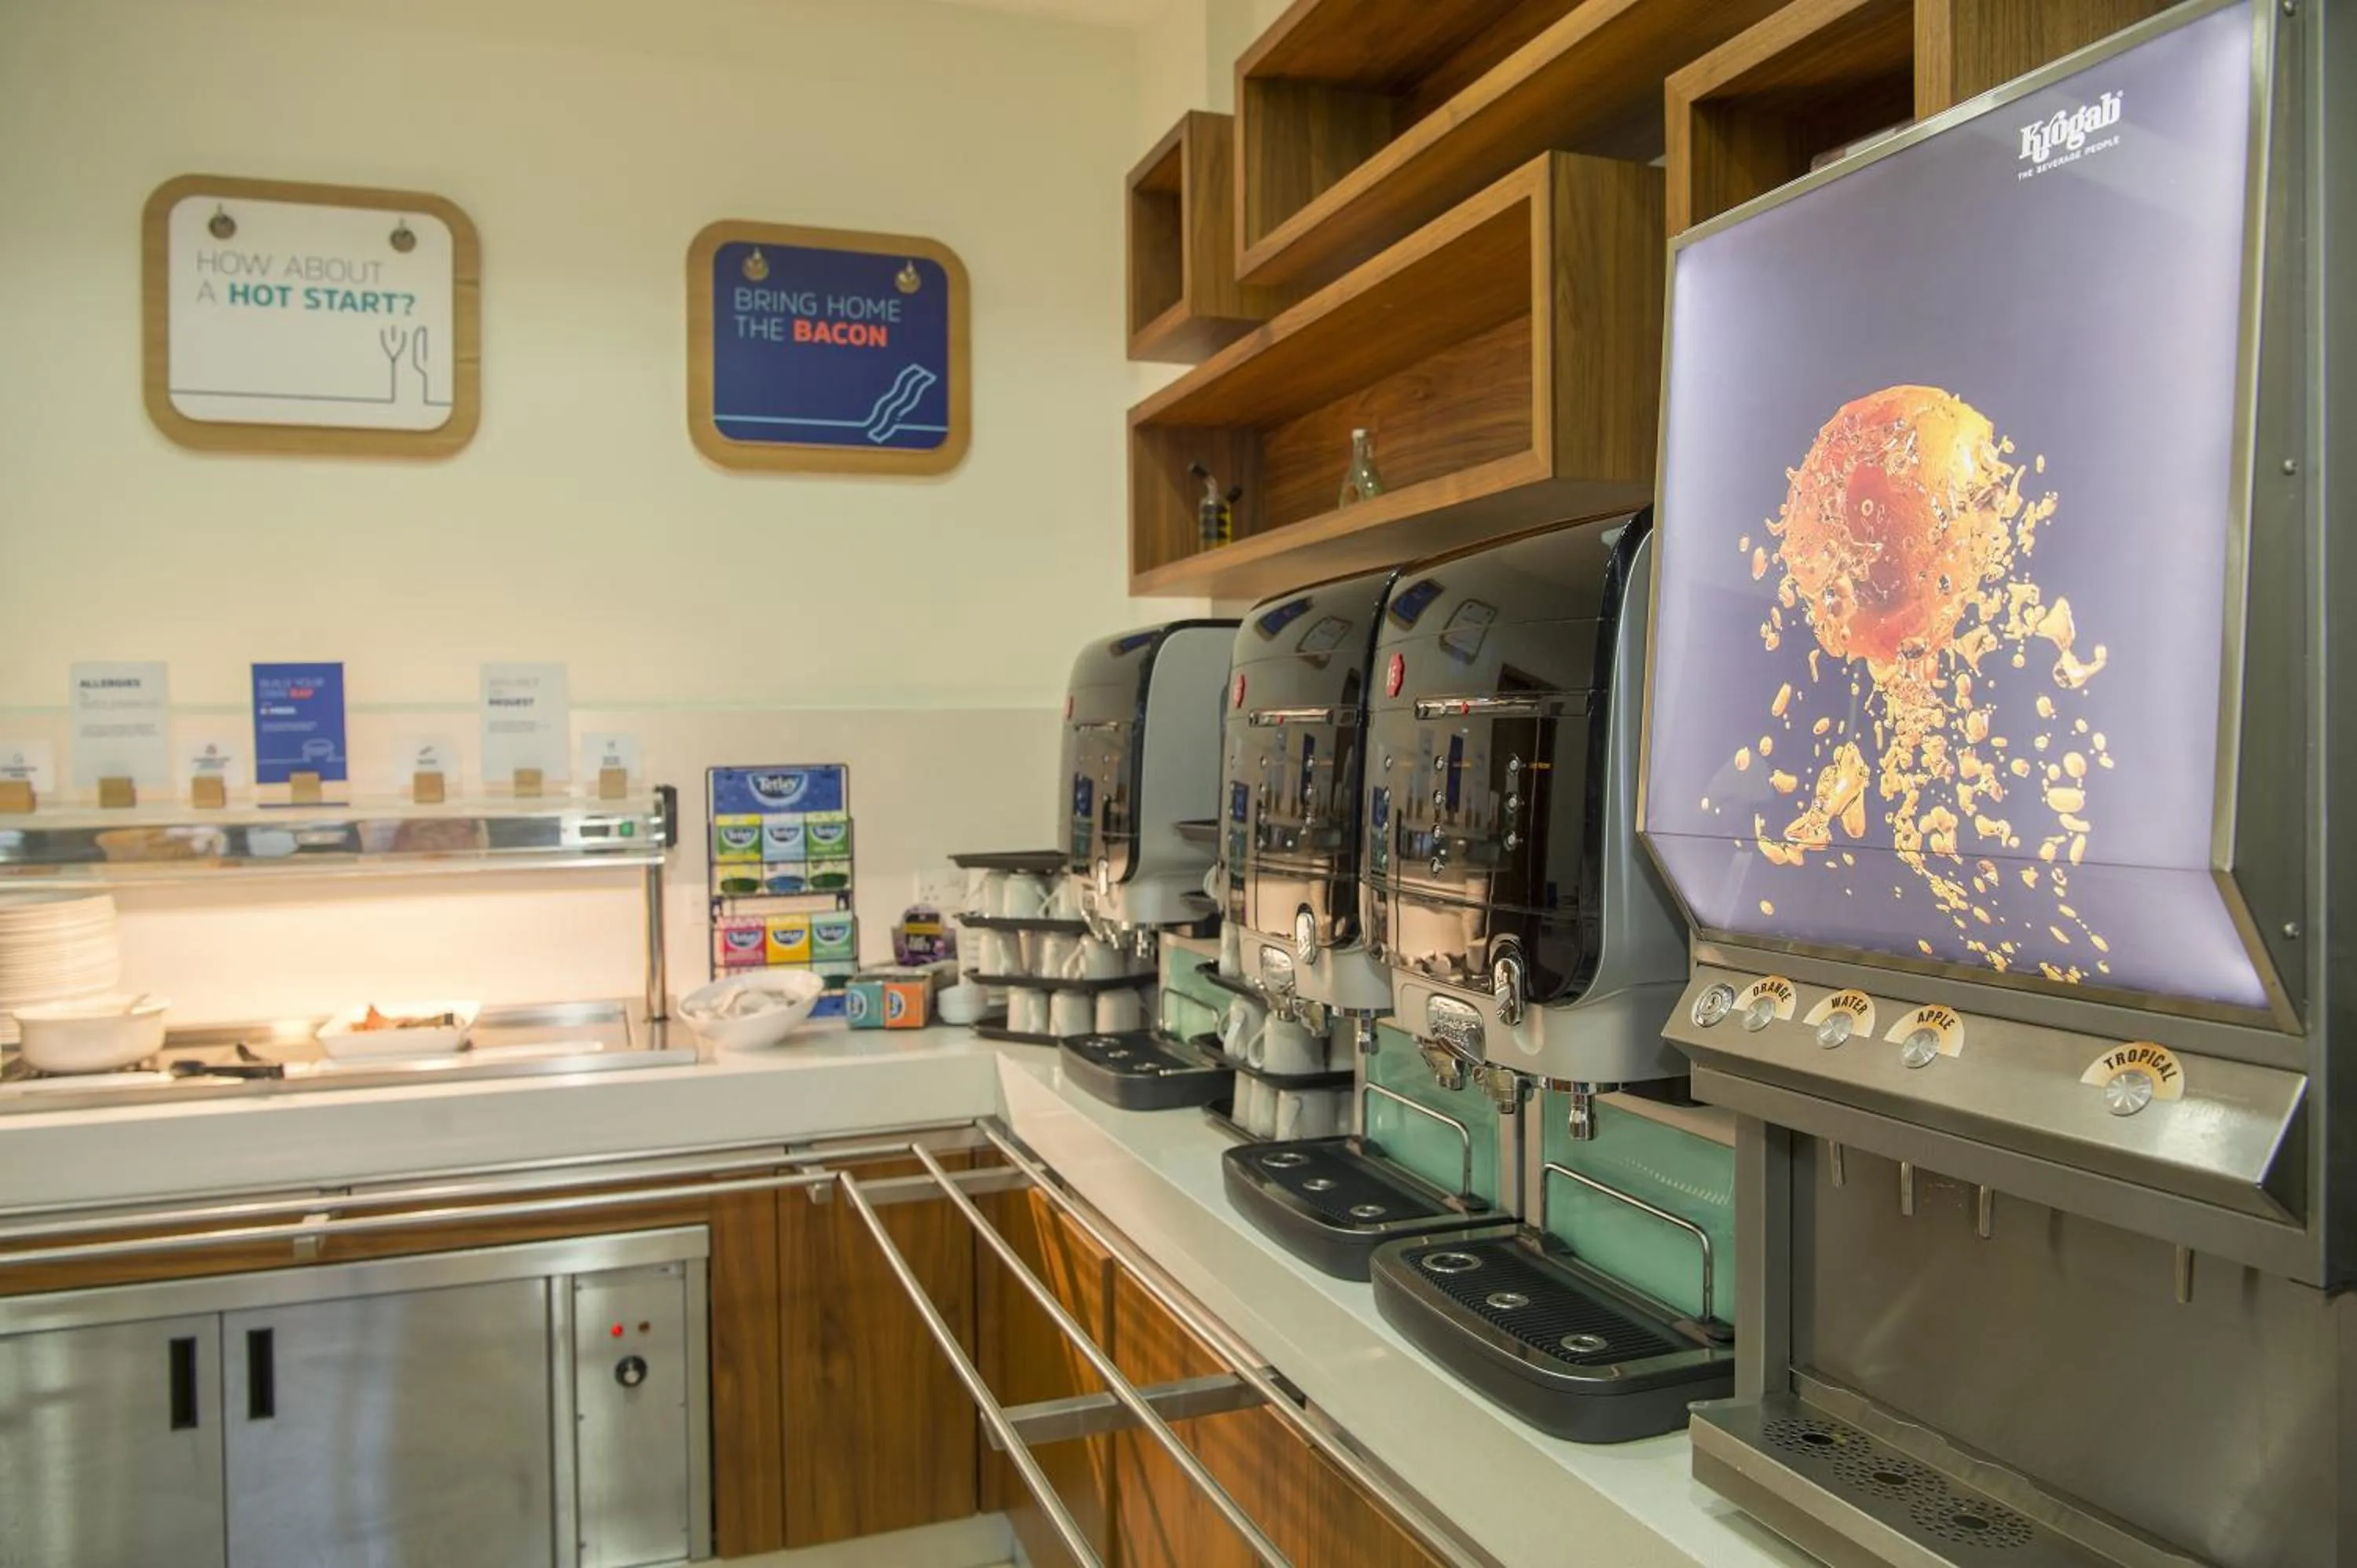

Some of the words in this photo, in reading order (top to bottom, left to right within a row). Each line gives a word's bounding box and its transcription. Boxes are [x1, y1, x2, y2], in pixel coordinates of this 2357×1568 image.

[2018, 169, 2033, 181] THE
[2036, 150, 2081, 174] BEVERAGE
[2084, 136, 2120, 156] PEOPLE
[196, 250, 273, 276] HOW
[284, 256, 384, 284] ABOUT
[196, 280, 216, 304] A
[229, 282, 292, 308] HOT
[303, 287, 416, 316] START?
[734, 287, 817, 316] BRING
[827, 295, 902, 322] HOME
[735, 315, 783, 341] THE
[794, 319, 888, 346] BACON
[757, 775, 800, 794] Tetley
[1753, 982, 1792, 1002] ORANGE
[1831, 996, 1868, 1015] WATER
[1916, 1010, 1956, 1031] APPLE
[2103, 1049, 2177, 1083] TROPICAL
